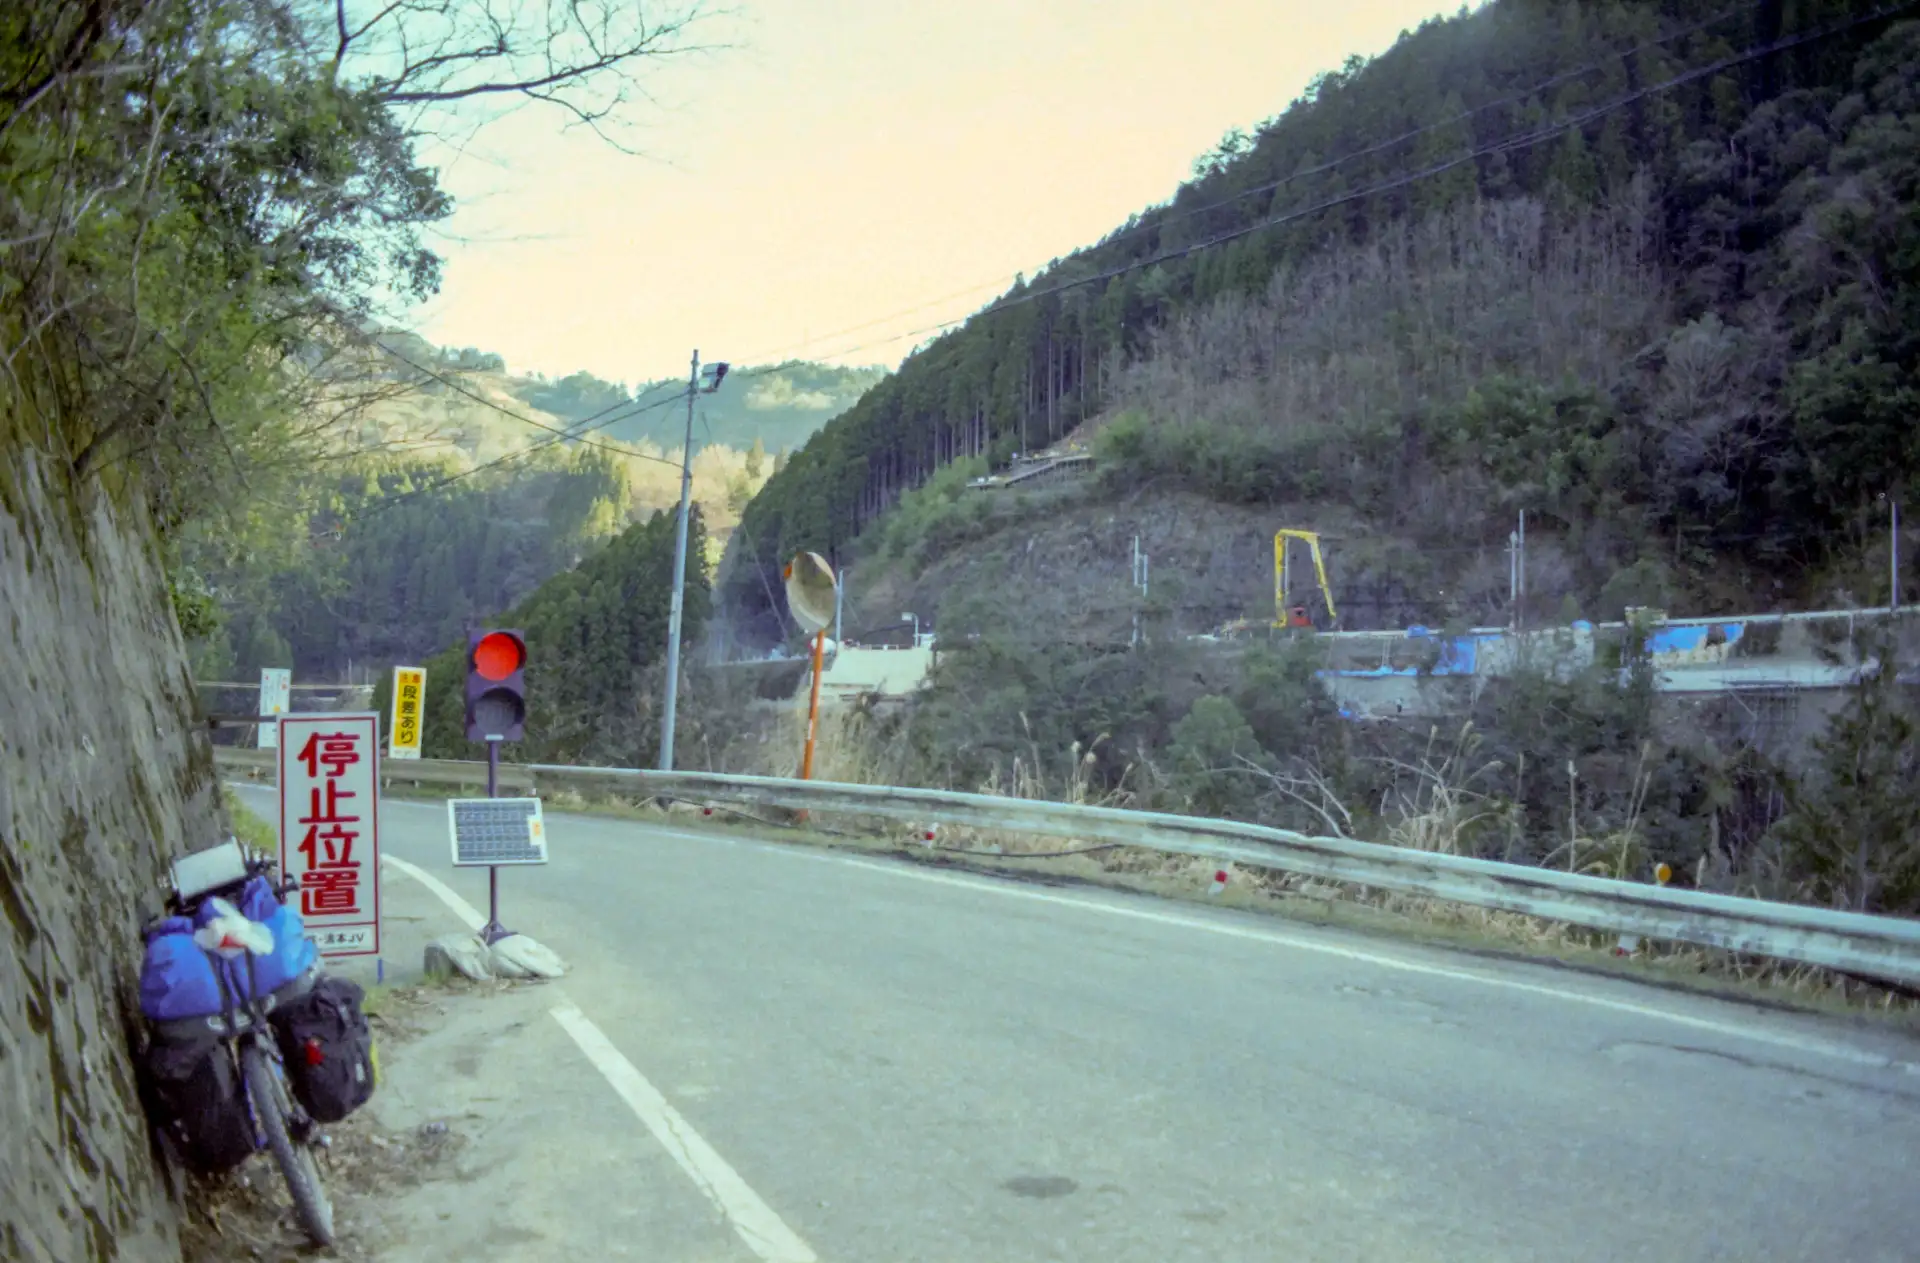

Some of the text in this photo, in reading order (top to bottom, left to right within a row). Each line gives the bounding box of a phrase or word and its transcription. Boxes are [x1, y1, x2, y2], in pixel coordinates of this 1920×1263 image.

[401, 685, 417, 744] 段差あり
[298, 731, 361, 916] 停止位置
